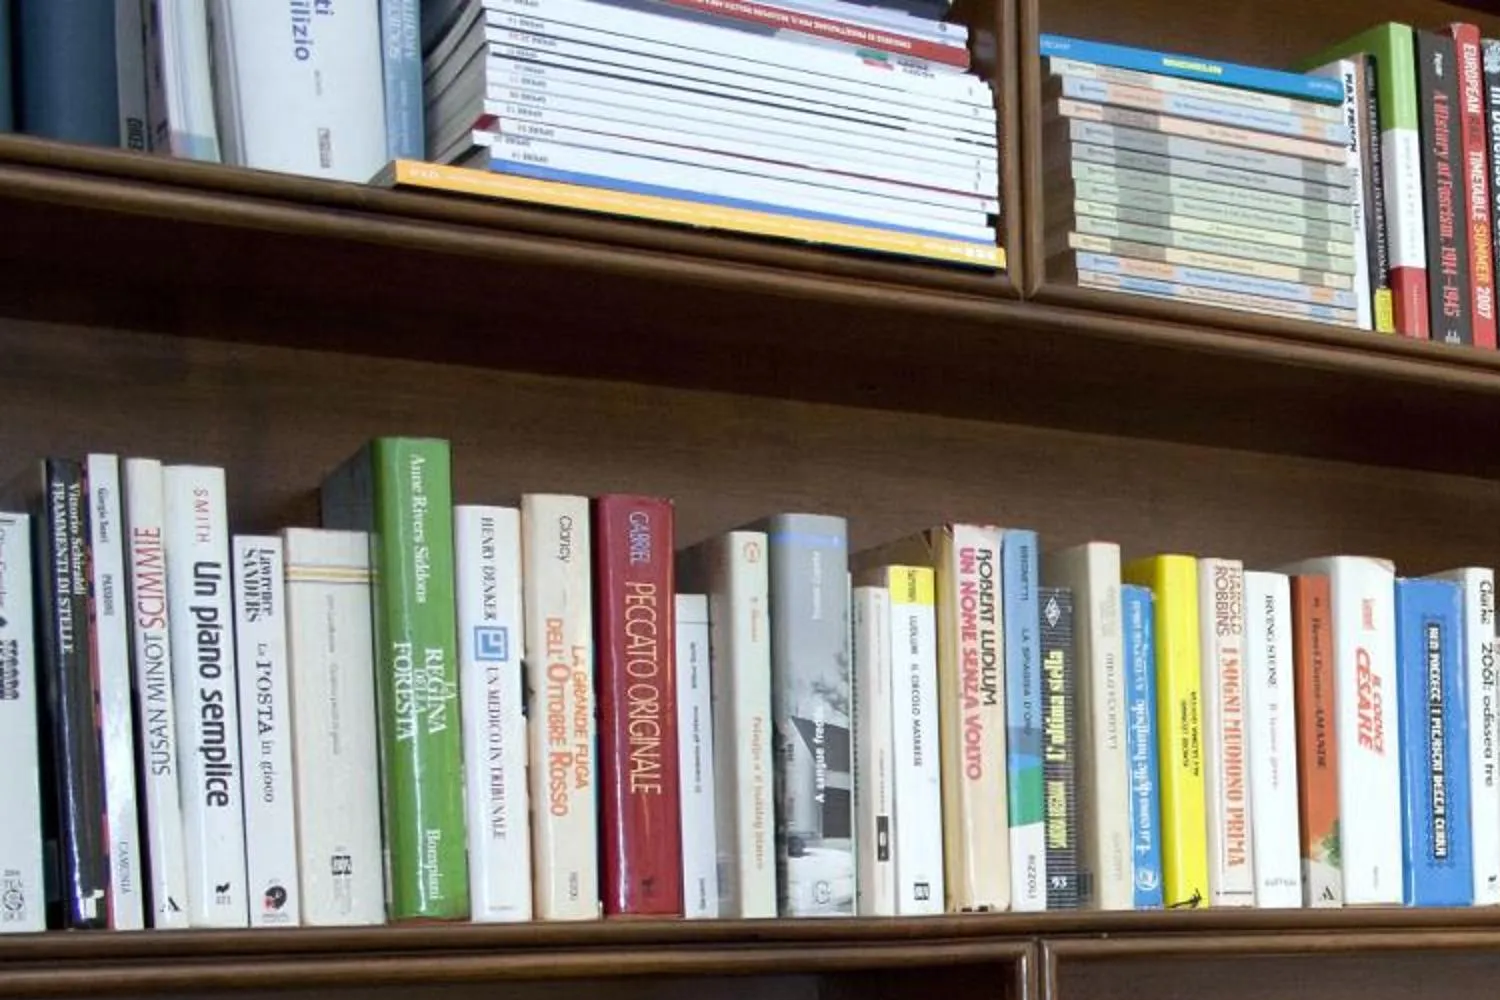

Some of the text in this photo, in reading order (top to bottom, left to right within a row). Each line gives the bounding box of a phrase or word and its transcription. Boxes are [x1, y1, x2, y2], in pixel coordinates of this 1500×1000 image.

[1344, 73, 1354, 105] MAX
[1463, 44, 1481, 113] EUROPEAN
[1433, 90, 1451, 176] A History of
[1469, 151, 1487, 221] TIMETABLE
[1375, 187, 1386, 276] INTERNATIONAL
[1472, 222, 1489, 283] SUMMER
[1475, 286, 1491, 319] 2007
[52, 482, 71, 573] FRAMMENTI
[68, 483, 83, 533] Vittorio
[194, 489, 209, 543] SMITH
[411, 454, 429, 602] Anne Rivers Siddons
[558, 515, 572, 562] Clancy
[629, 512, 649, 564] GABRIEL
[57, 578, 70, 594] DI
[243, 549, 260, 622] SANDERS
[259, 549, 274, 616] Lawrence
[480, 517, 497, 621] HENRY DENKER
[1214, 565, 1230, 637] ROBBINS
[1229, 566, 1243, 636] HAROLD
[1479, 580, 1493, 625] Clarke
[134, 528, 171, 776] SUSAN MINOT SCIMMIE
[978, 549, 997, 706] ROBERT LUDLUM
[1264, 594, 1276, 641] IRVING
[1429, 627, 1440, 650] KEN
[190, 561, 231, 807] Un piano semplice
[256, 661, 273, 735] POSTA
[393, 642, 413, 742] FORESTA
[426, 648, 445, 734] REGINA
[625, 582, 662, 795] PECCATO ORIGINALE
[911, 675, 920, 715] CIRCOLO
[960, 547, 982, 780] UN NOME SENZA VOLTO
[1043, 649, 1065, 692] stella
[1222, 660, 1240, 711] SOGNI
[1266, 645, 1278, 689] STONE
[1355, 648, 1374, 748] CESARE
[262, 740, 275, 756] in
[572, 645, 590, 789] LA GRANDE FUGA
[1372, 675, 1385, 757] IL CODICE
[1481, 642, 1496, 787] 2061: odissea tre
[261, 760, 276, 803] gioco
[486, 667, 505, 840] UN MEDICO IN TRIBUNALE
[550, 752, 573, 816] ROSSO
[813, 748, 828, 802] A sangue
[426, 829, 442, 900] Bompiani
[1226, 807, 1244, 867] PRIMA
